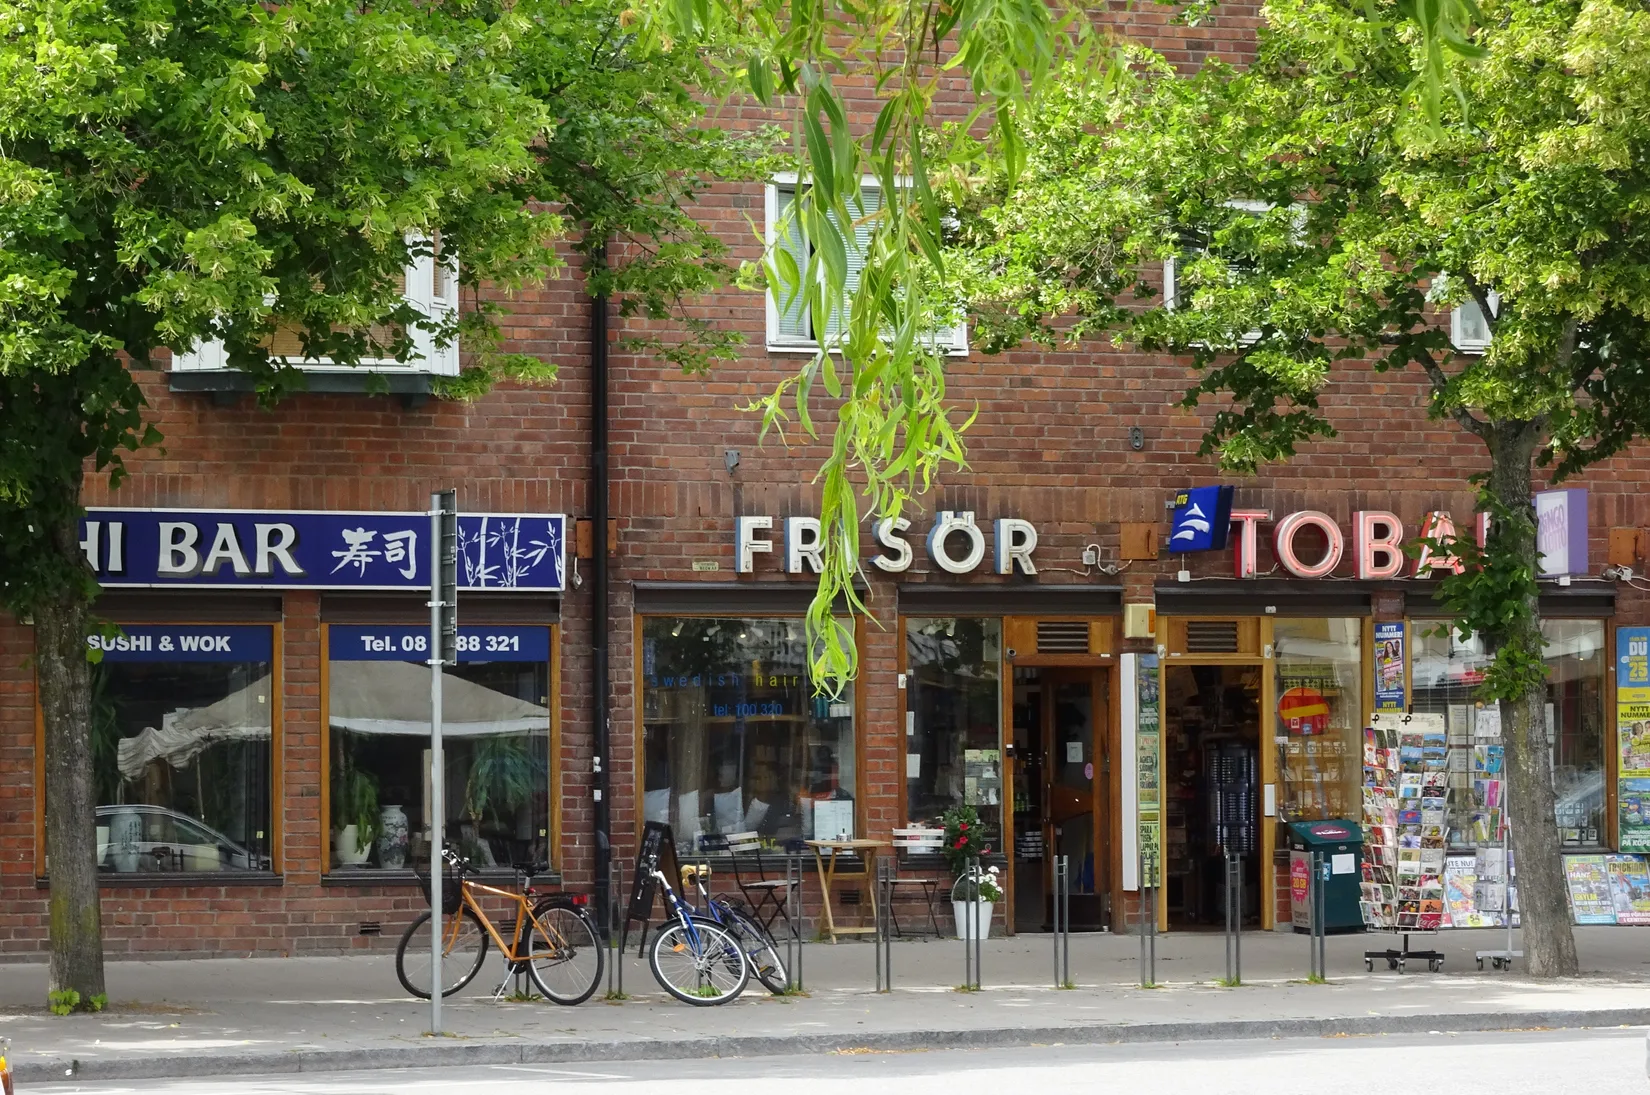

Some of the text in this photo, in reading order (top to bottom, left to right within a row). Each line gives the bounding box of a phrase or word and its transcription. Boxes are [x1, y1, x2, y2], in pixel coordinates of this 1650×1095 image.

[157, 522, 304, 575] BAR
[330, 527, 417, 580] 寿司
[1230, 510, 1492, 580] TOBA
[87, 635, 232, 652] SUSHI & WOK
[361, 635, 396, 652] Tel.
[401, 635, 427, 652] 08
[485, 635, 519, 652] 321
[1629, 641, 1648, 656] DU
[1629, 661, 1648, 678] 25
[650, 672, 798, 687] swedish hair
[736, 703, 757, 716] 100
[760, 703, 783, 716] 320
